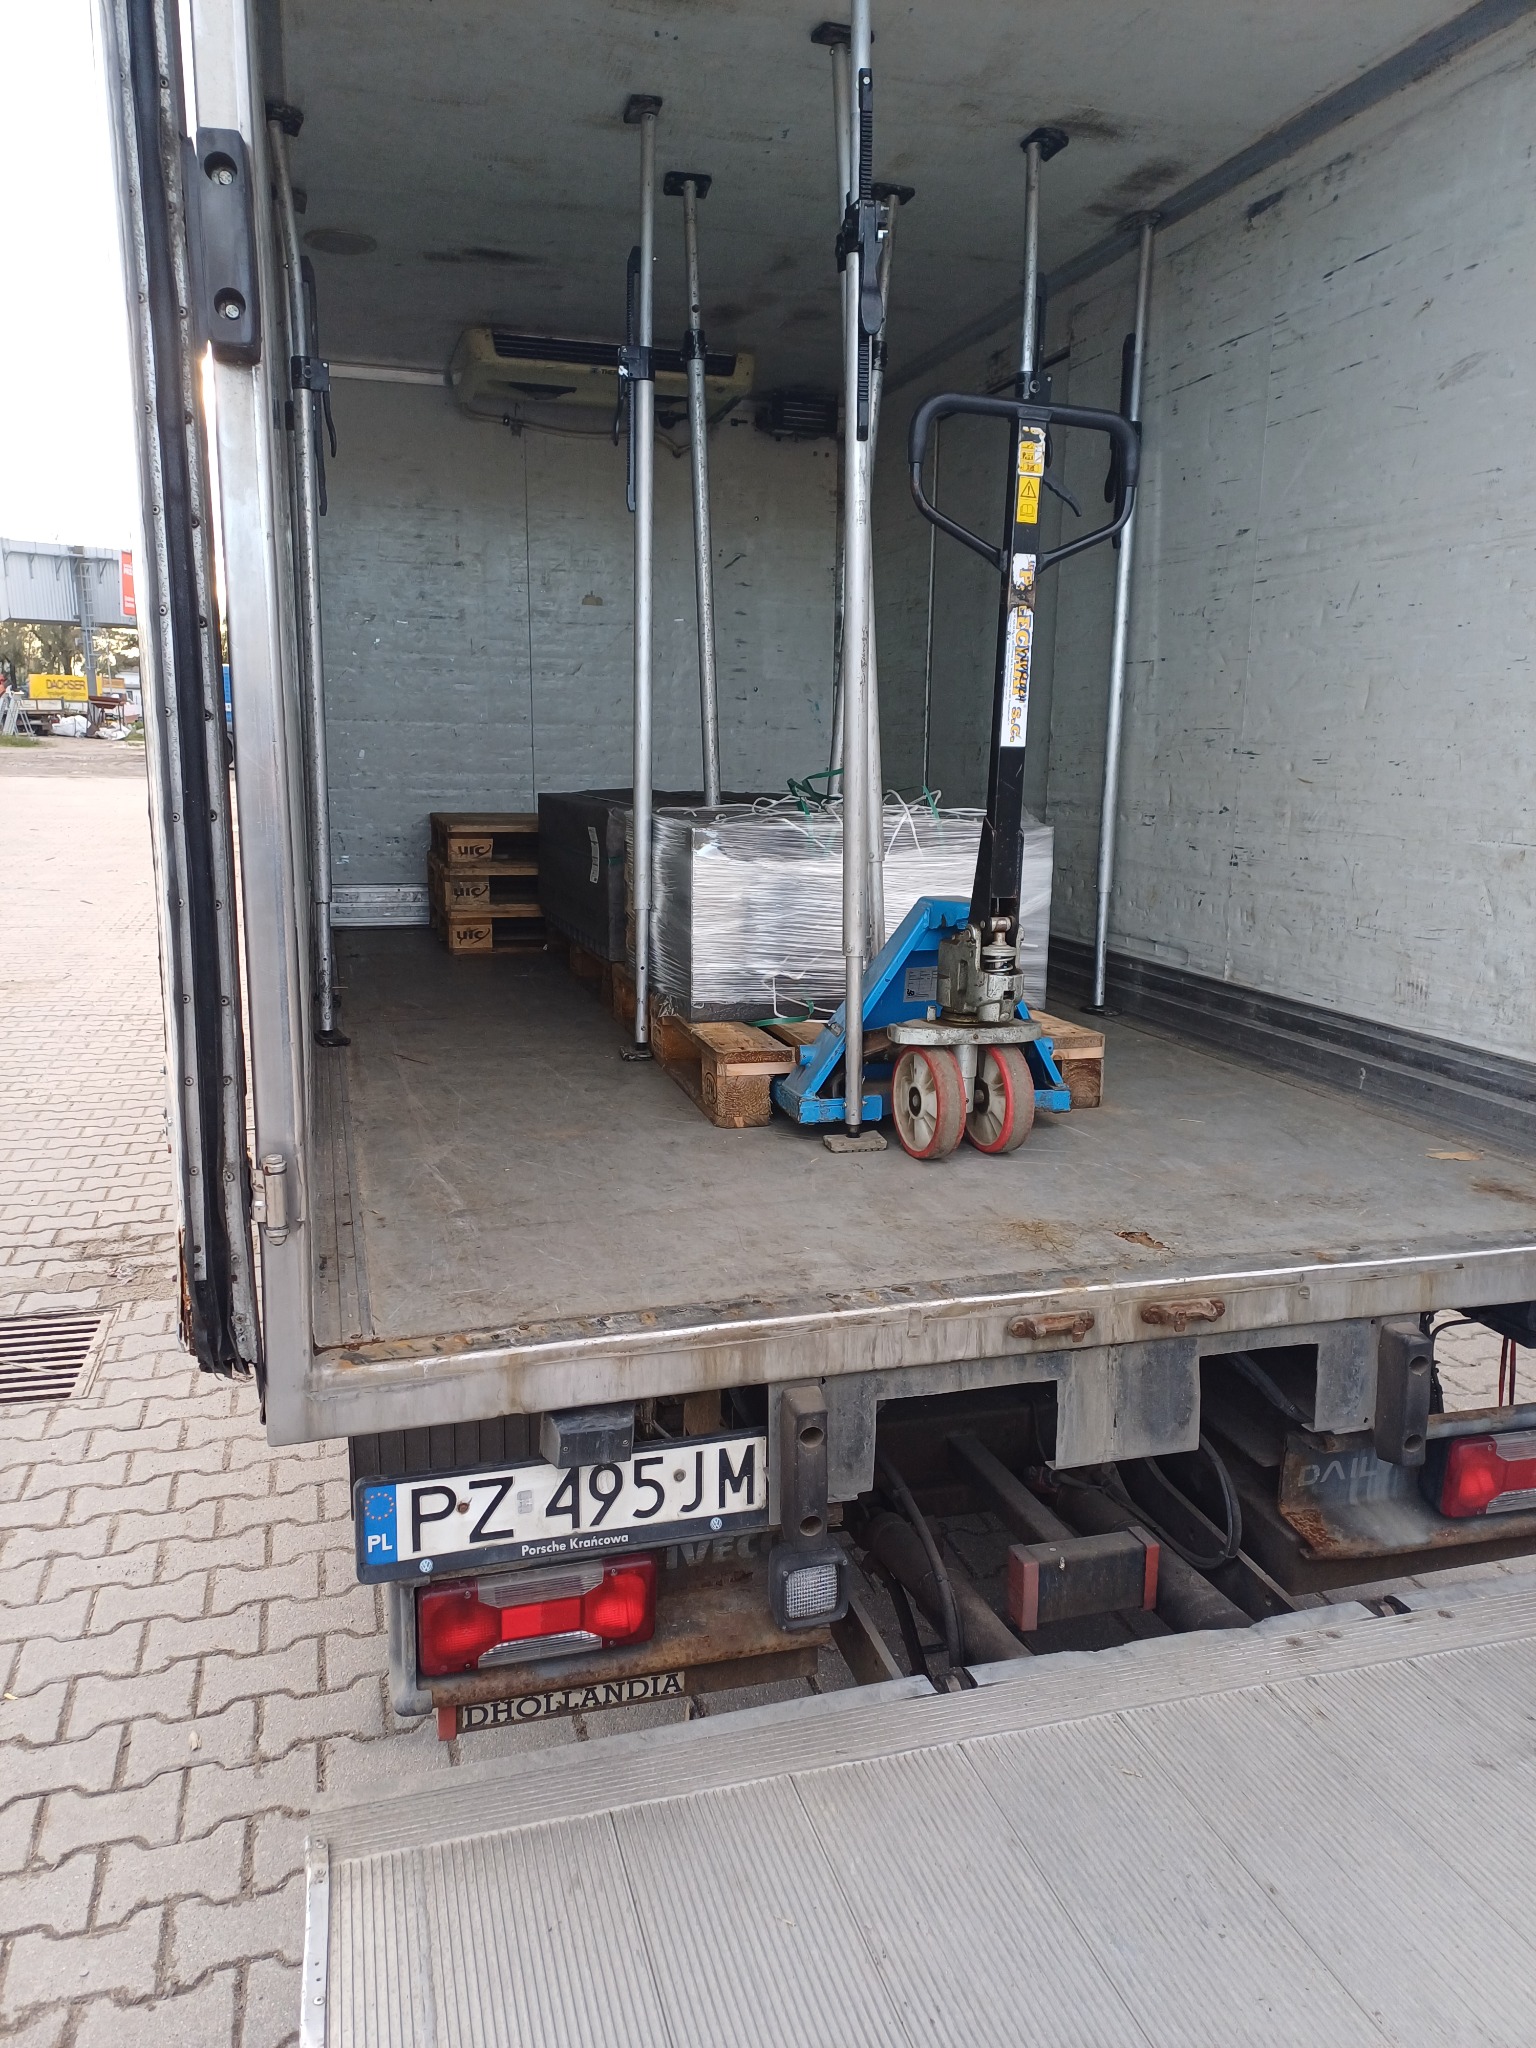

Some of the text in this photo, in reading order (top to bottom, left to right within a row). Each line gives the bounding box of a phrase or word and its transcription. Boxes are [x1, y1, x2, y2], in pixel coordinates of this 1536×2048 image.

[46, 679, 86, 691] DACHSER
[411, 1475, 514, 1553] PZ
[367, 1532, 393, 1553] PL
[521, 1534, 629, 1557] Porsche Krańcowa
[464, 1673, 683, 1728] DHOLLANDIA
